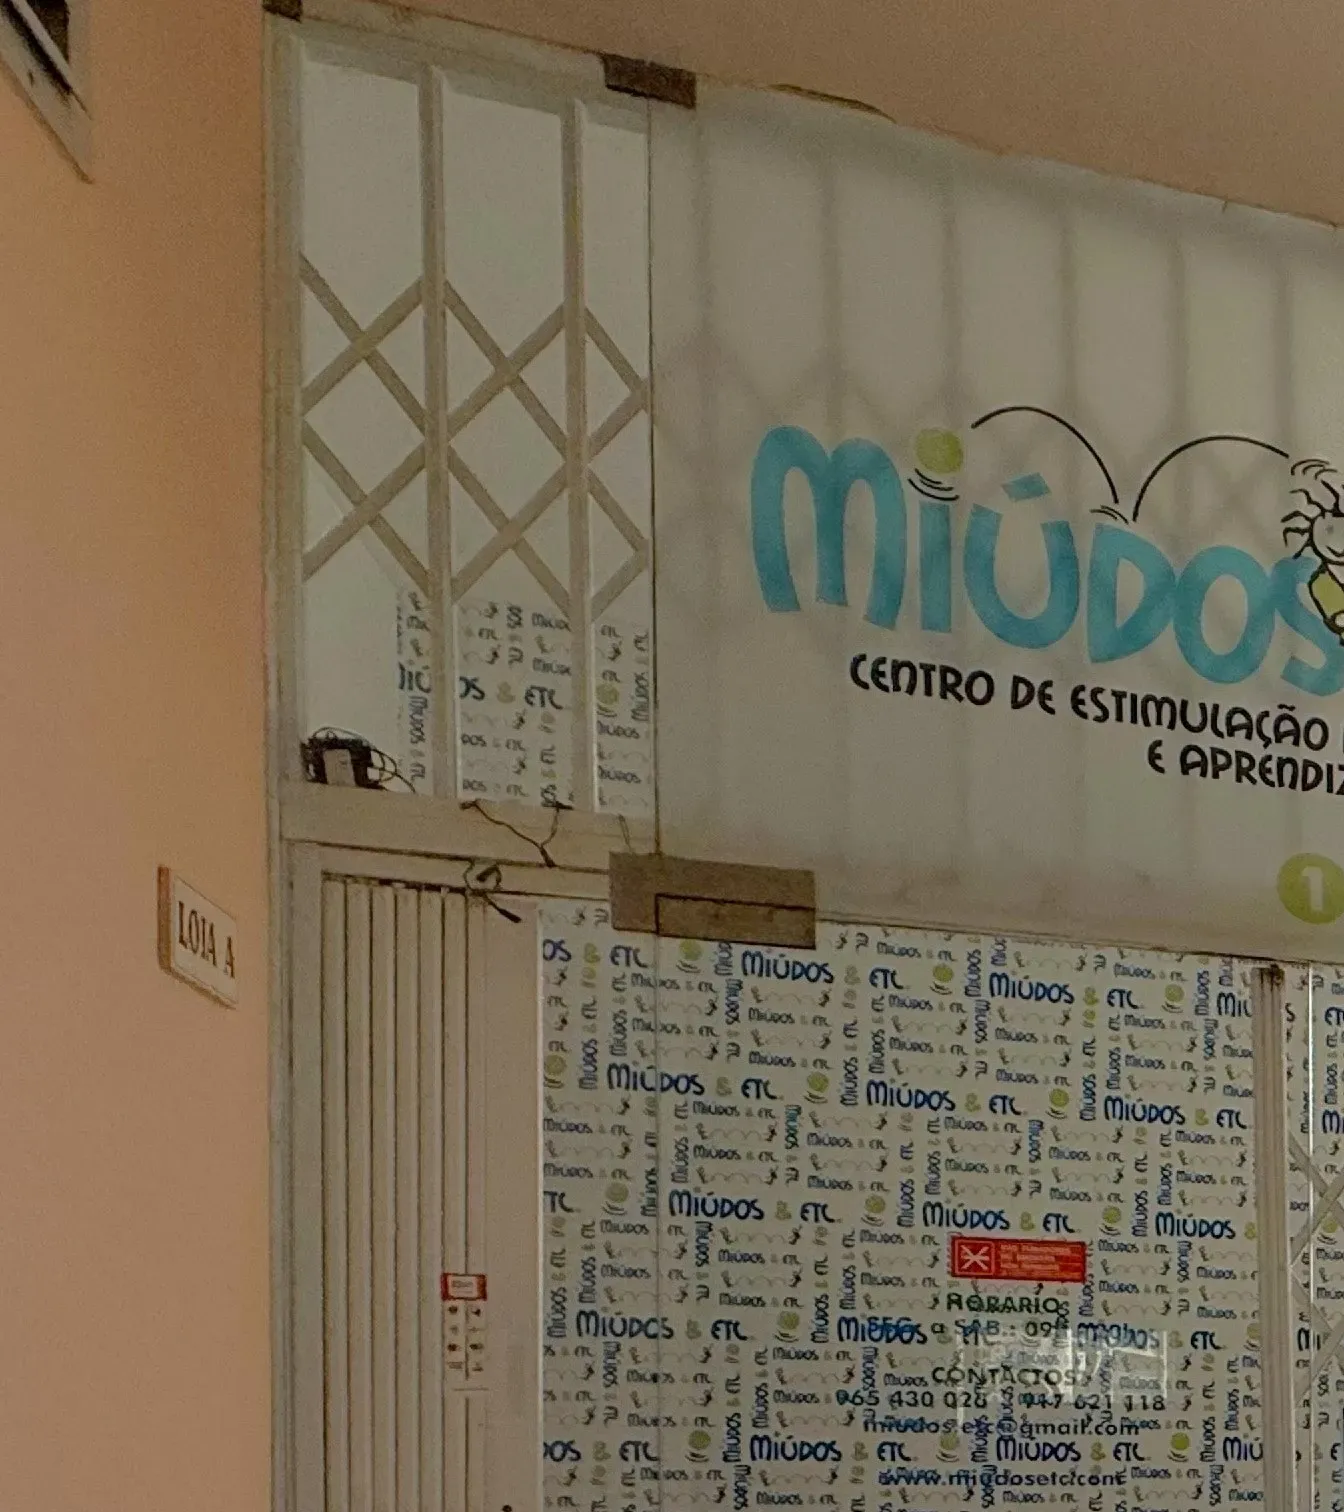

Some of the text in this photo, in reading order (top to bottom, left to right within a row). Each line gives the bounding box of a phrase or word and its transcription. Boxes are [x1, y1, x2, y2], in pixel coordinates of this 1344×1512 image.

[850, 652, 995, 708] CENTRO
[1011, 670, 1057, 717] DE
[1070, 683, 1330, 752] ESTIMULAÇÃO
[1147, 738, 1166, 775] E
[223, 936, 236, 979] A
